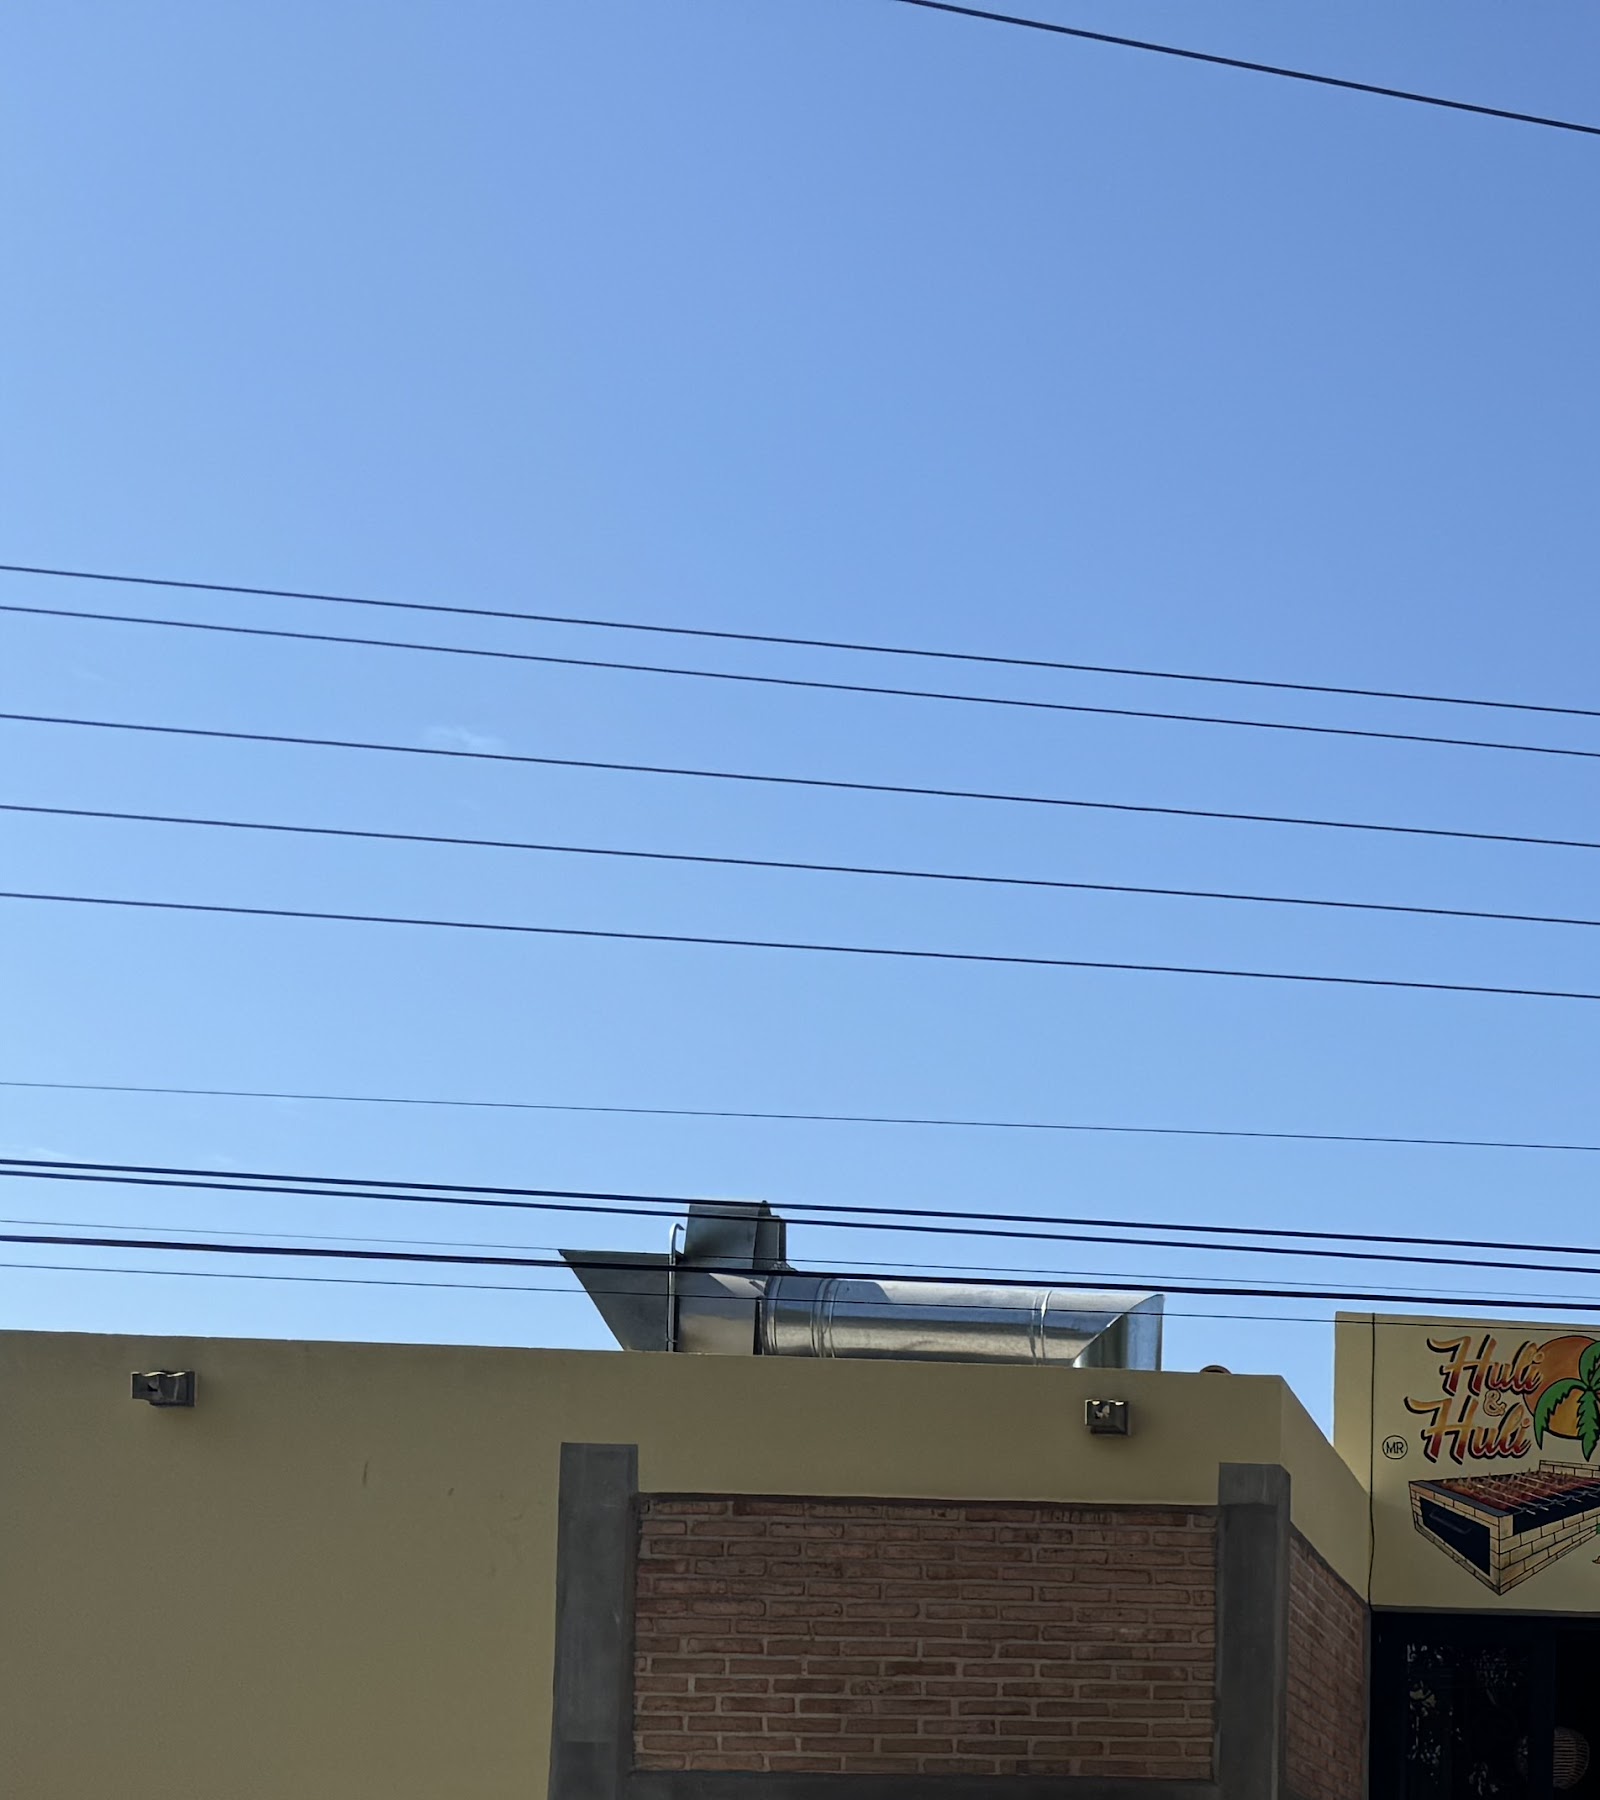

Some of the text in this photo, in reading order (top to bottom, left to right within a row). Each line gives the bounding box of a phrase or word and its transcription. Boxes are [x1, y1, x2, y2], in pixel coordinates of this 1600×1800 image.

[1426, 1334, 1545, 1397] Huli
[1403, 1394, 1532, 1465] Huli
[1483, 1389, 1507, 1417] &
